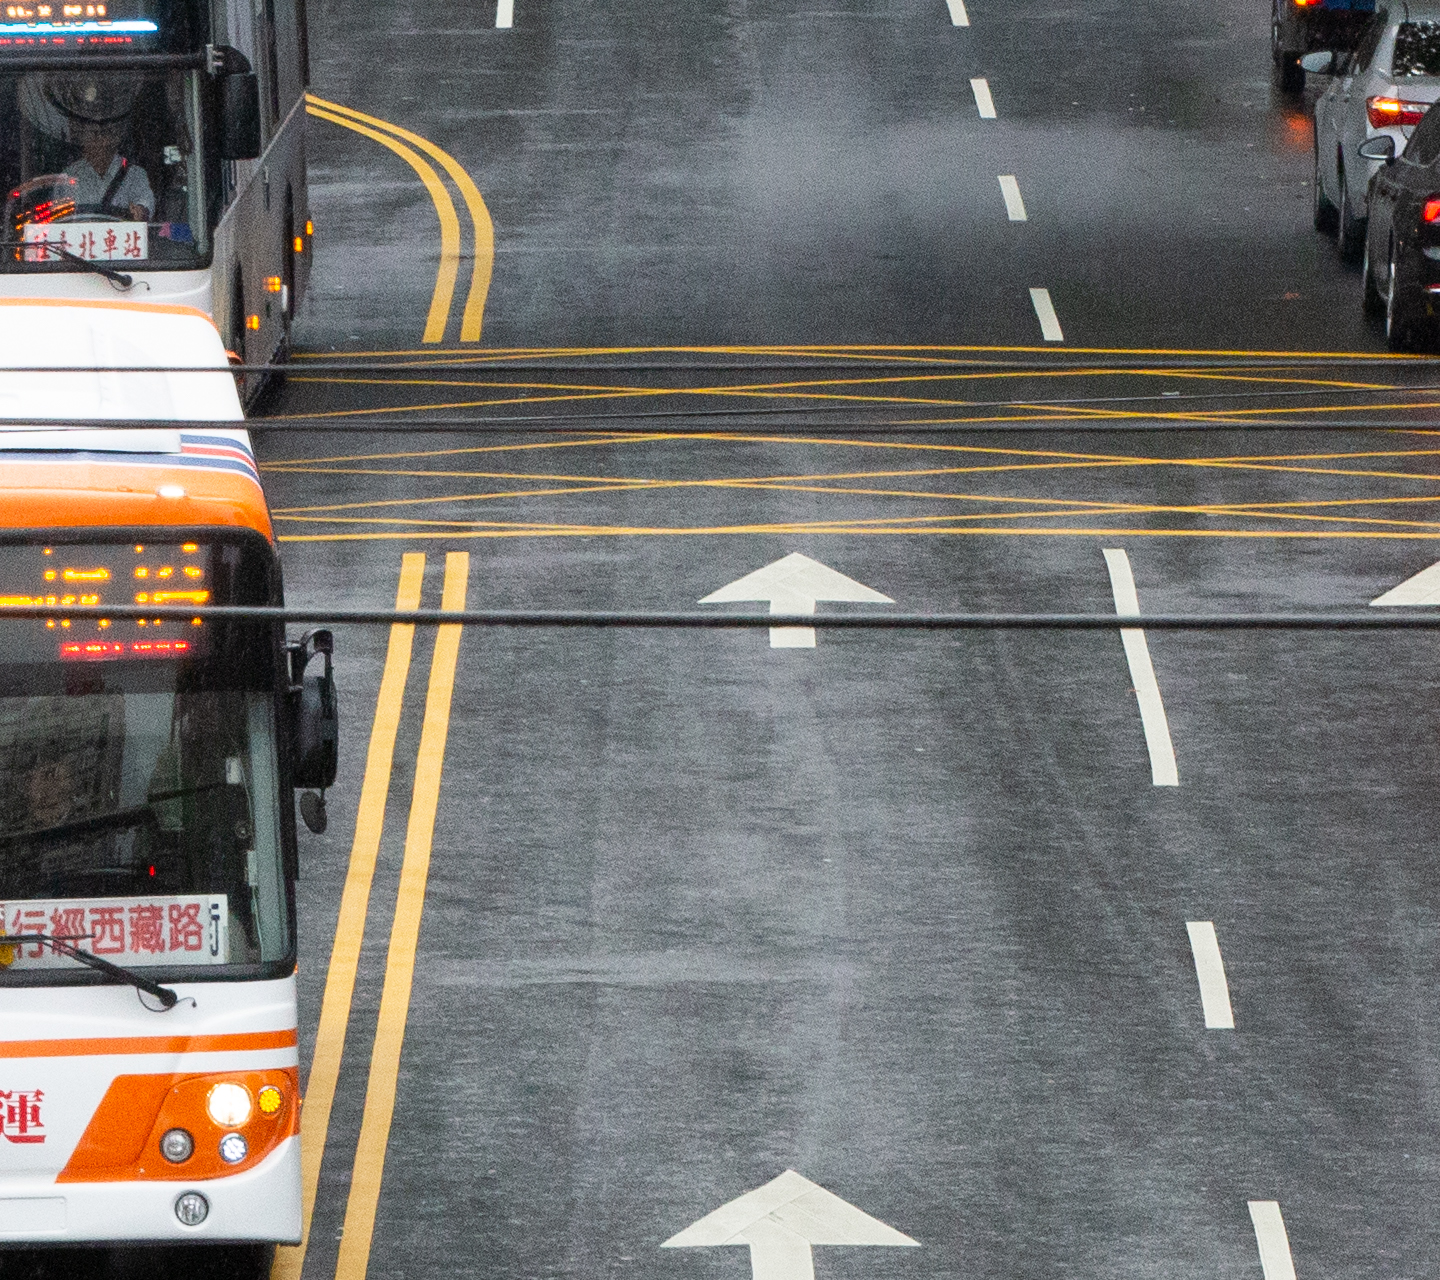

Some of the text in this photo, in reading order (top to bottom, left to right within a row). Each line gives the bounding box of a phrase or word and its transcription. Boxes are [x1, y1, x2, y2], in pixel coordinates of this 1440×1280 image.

[12, 903, 203, 959] 行經西藏路
